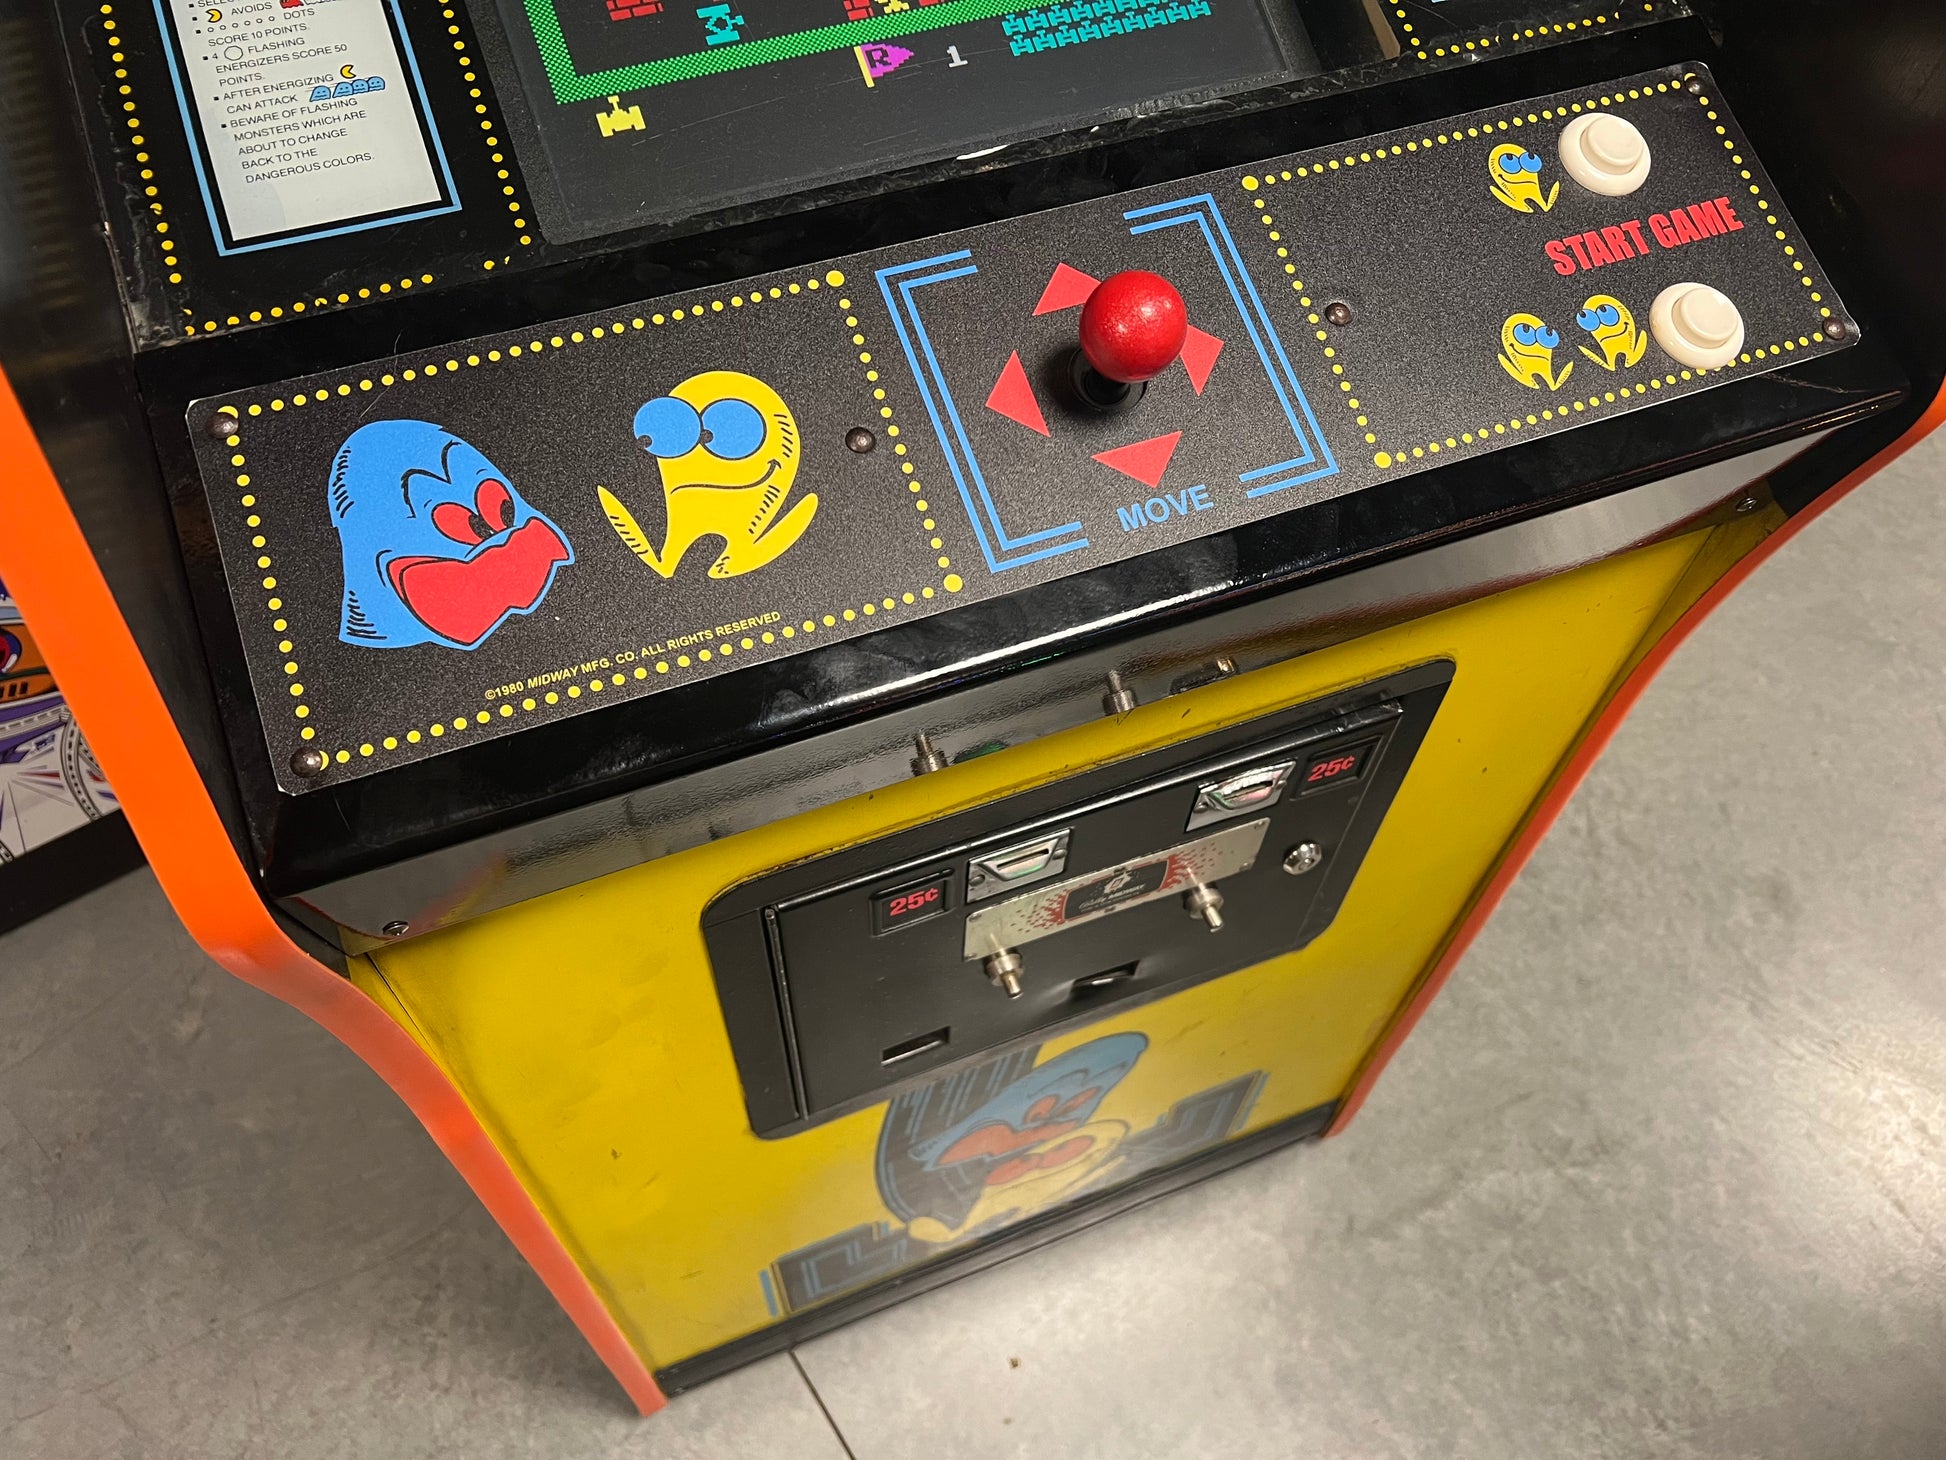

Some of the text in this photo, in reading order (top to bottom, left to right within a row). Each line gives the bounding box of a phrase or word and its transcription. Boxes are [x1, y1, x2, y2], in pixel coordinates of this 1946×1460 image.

[231, 2, 272, 15] AVOIDS
[283, 8, 315, 20] DOTS
[208, 23, 310, 46] SCORE 10 POINTS.
[247, 37, 305, 54] FLASHING
[215, 43, 348, 73] ENERGIZERS SCORE 50
[865, 47, 892, 69] R
[946, 45, 968, 68] 1
[223, 74, 334, 101] AFTER ENERGIZING
[226, 94, 298, 115] CAN ATTACK
[229, 98, 358, 128] BEWARE OF FLASHING
[233, 110, 367, 142] MONSTERS WHICH ARE
[238, 128, 348, 156] ABOUT TO CHANGE
[241, 148, 318, 169] BACK TO THE
[245, 152, 375, 184] DANGEROUS COLORS.
[1544, 196, 1745, 276] START GAME
[1116, 483, 1215, 532] MOVE
[484, 611, 781, 700] ©1980 MIDWAY MFG. CO. ALL RIGHTS RESERVED
[1307, 755, 1356, 782] 25¢
[889, 887, 939, 917] 25¢
